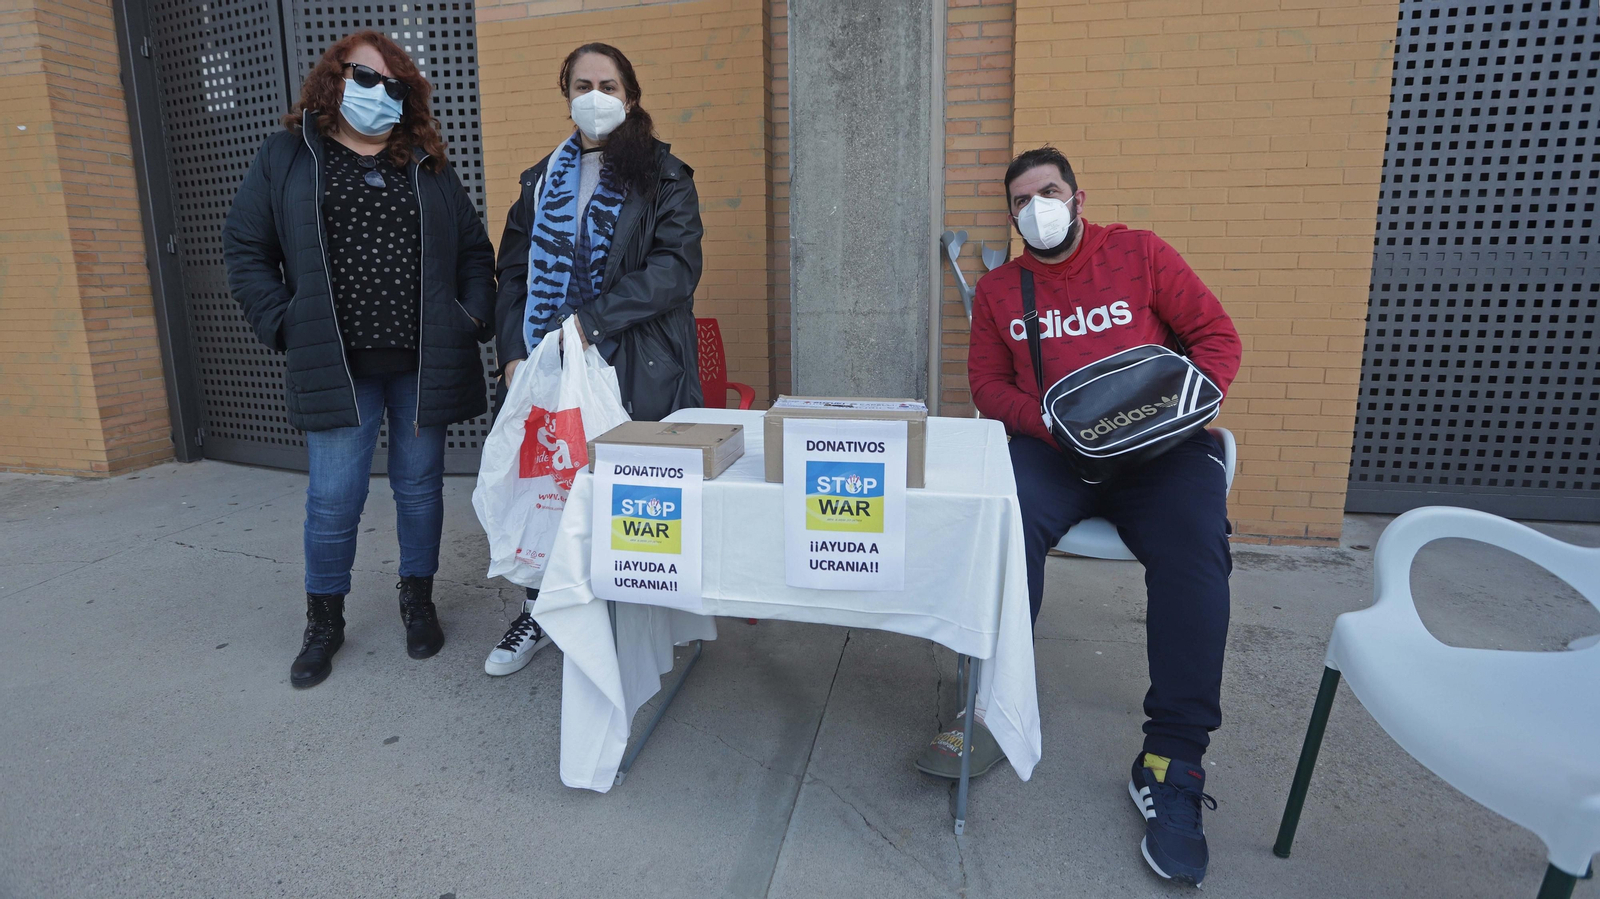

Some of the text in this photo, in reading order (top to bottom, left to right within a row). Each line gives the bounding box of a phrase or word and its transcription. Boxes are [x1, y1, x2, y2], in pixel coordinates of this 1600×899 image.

[1010, 300, 1133, 341] adidas
[1080, 403, 1158, 441] adidas
[806, 440, 886, 453] DONATIVOS
[614, 464, 684, 479] DONATIVOS
[816, 475, 878, 494] STOP
[621, 498, 676, 517] STOP
[818, 499, 871, 517] WAR
[622, 520, 670, 538] WAR
[810, 541, 879, 554] ¡¡AYUDA A
[614, 560, 678, 575] ¡¡AYUDA A
[809, 559, 879, 573] UCRANIA!!
[614, 577, 678, 592] UCRANIA!!
